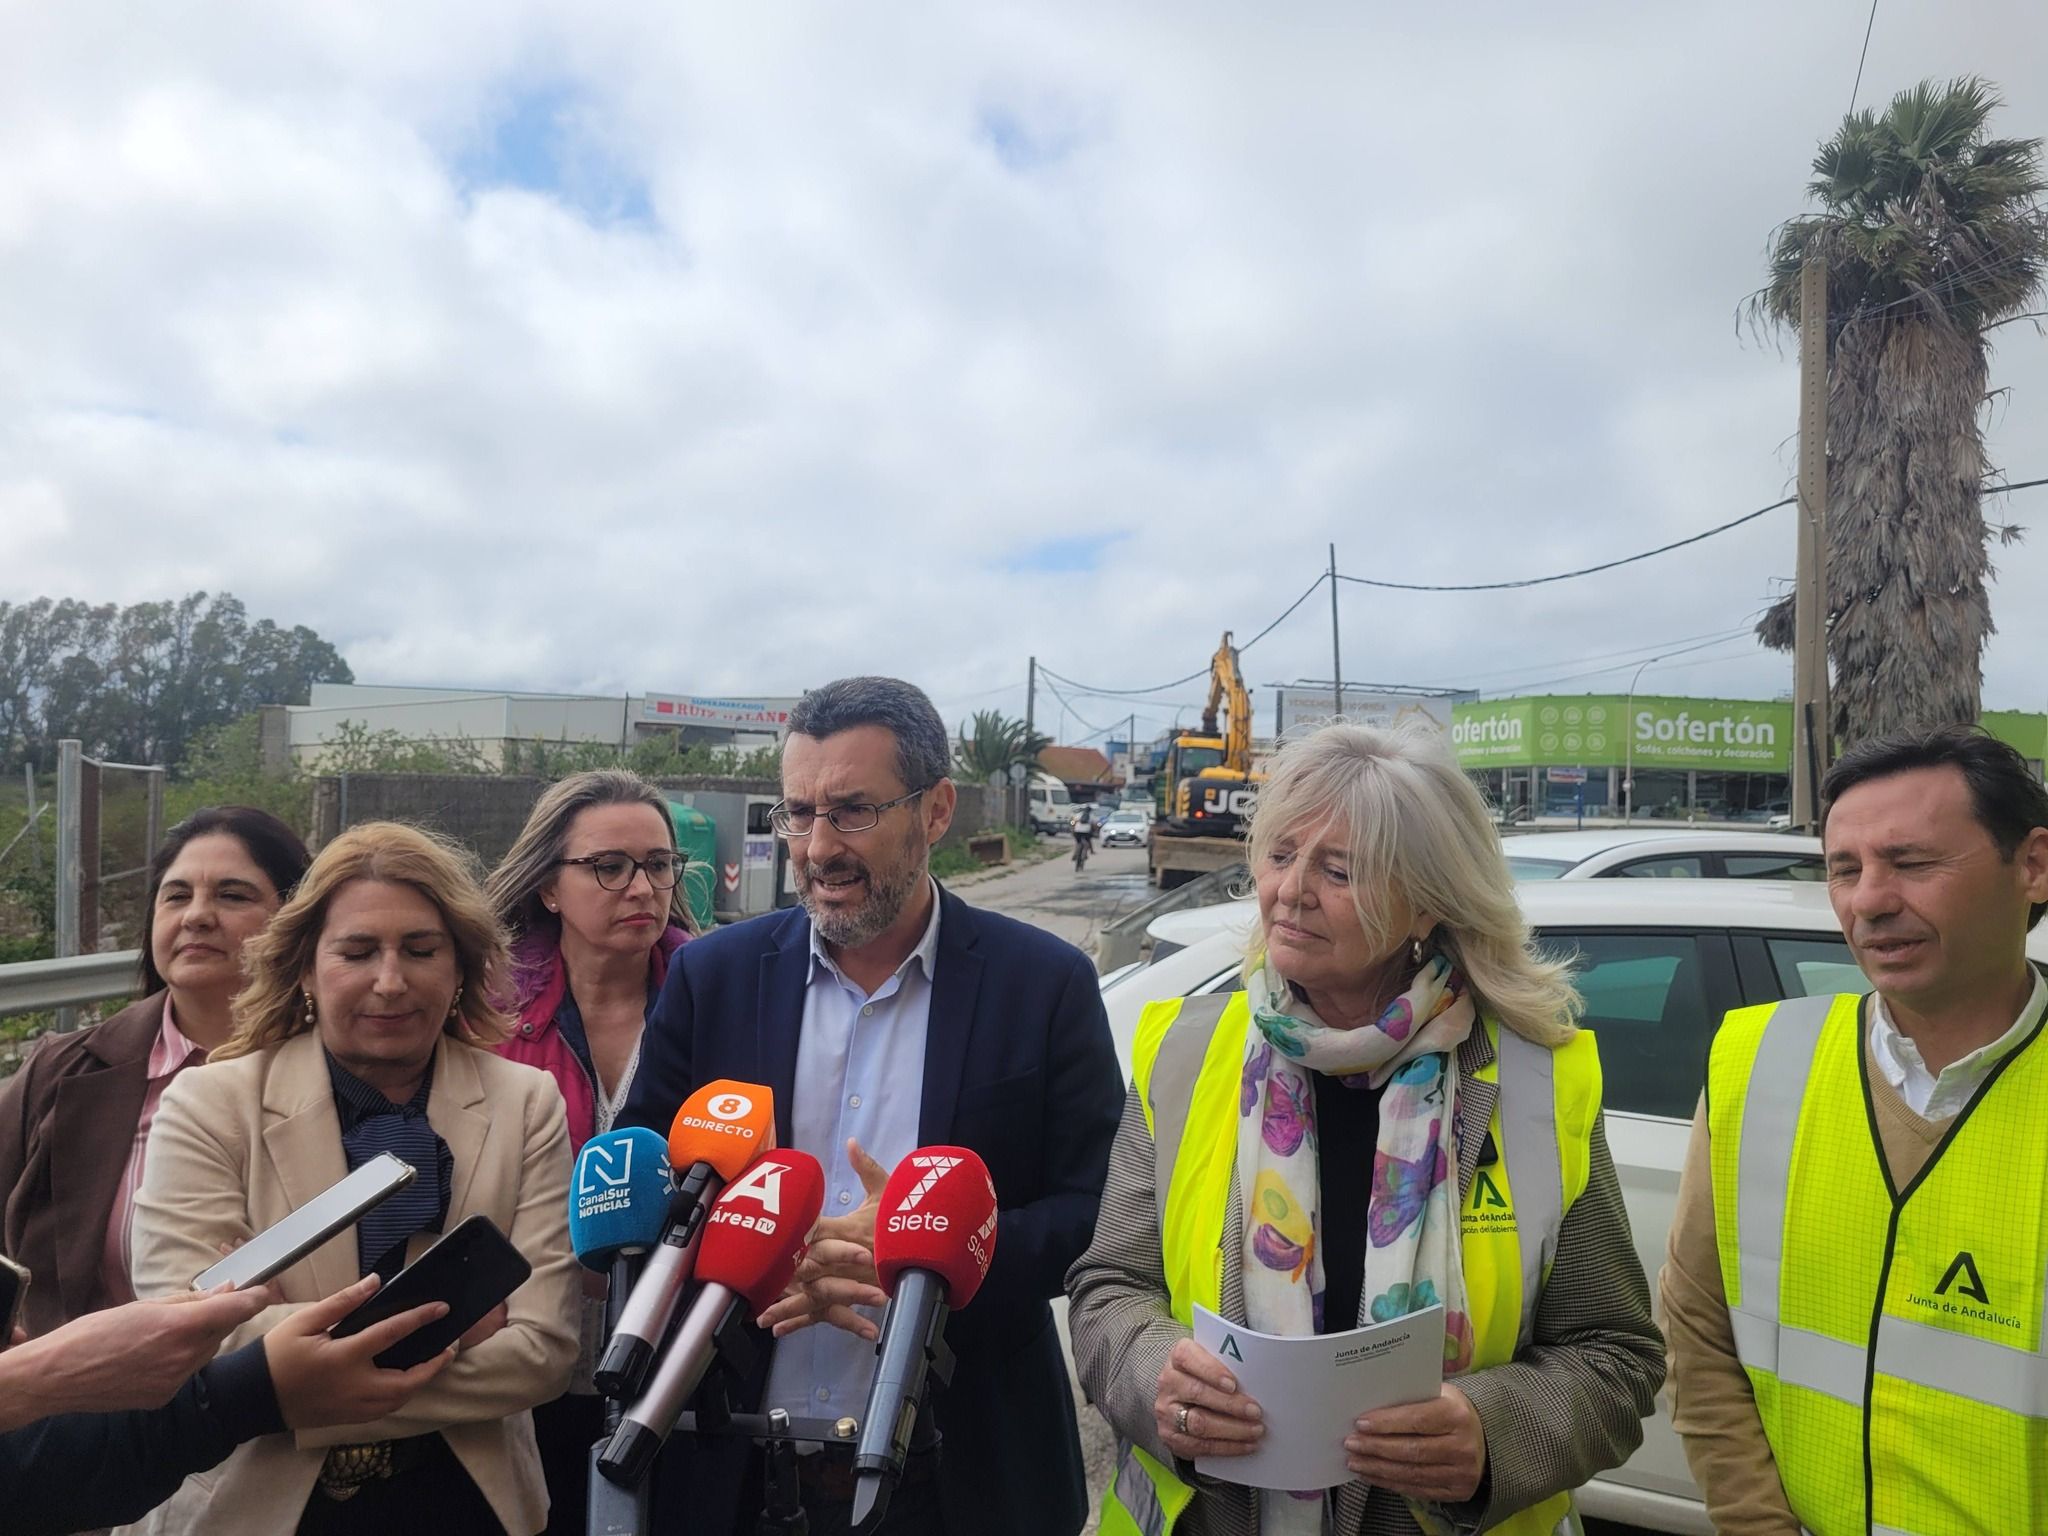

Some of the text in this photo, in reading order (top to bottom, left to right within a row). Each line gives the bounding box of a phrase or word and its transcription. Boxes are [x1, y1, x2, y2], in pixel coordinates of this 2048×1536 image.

[677, 703, 716, 719] RUIZ
[1452, 712, 1522, 744] ofertón
[1635, 711, 1775, 745] Sofertón
[1667, 745, 1714, 757] colchones
[1715, 748, 1721, 758] y
[1723, 747, 1775, 759] decoración
[1204, 789, 1259, 815] JC
[718, 1098, 741, 1115] 8
[682, 1116, 754, 1138] 8DIRECTO
[578, 1187, 631, 1208] CanalSur
[579, 1198, 631, 1219] NOTICIAS
[708, 1206, 755, 1230] Área
[758, 1219, 775, 1233] TV
[887, 1212, 949, 1232] siete
[1906, 1293, 2021, 1329] Junta de Andalucía
[1335, 1349, 1359, 1359] Junta
[1360, 1345, 1371, 1353] de
[1371, 1332, 1410, 1351] Andalucía
